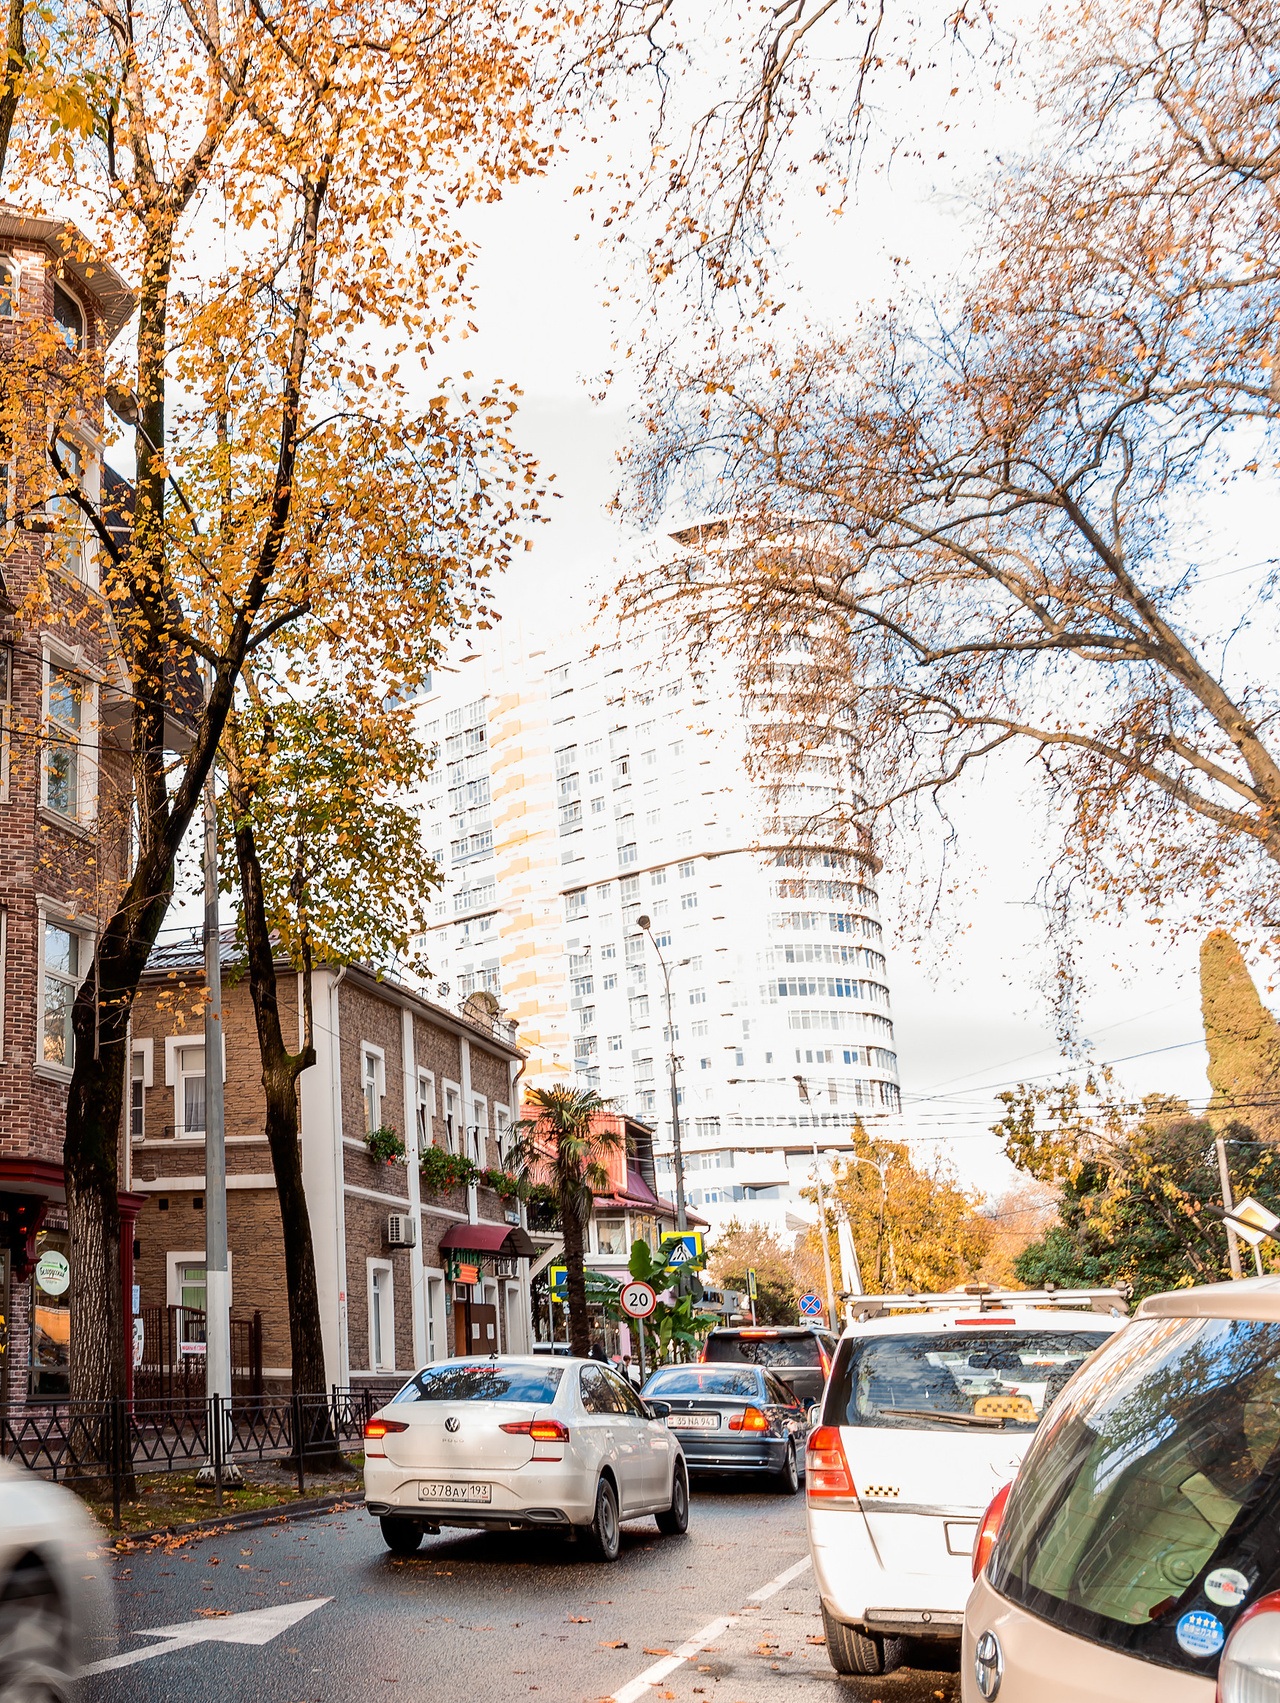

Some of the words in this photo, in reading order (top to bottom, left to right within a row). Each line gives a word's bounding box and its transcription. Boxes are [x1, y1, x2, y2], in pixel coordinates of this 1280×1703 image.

[629, 1293, 648, 1306] 20
[677, 1416, 687, 1425] 35
[701, 1417, 715, 1426] 941
[470, 1485, 487, 1495] 193
